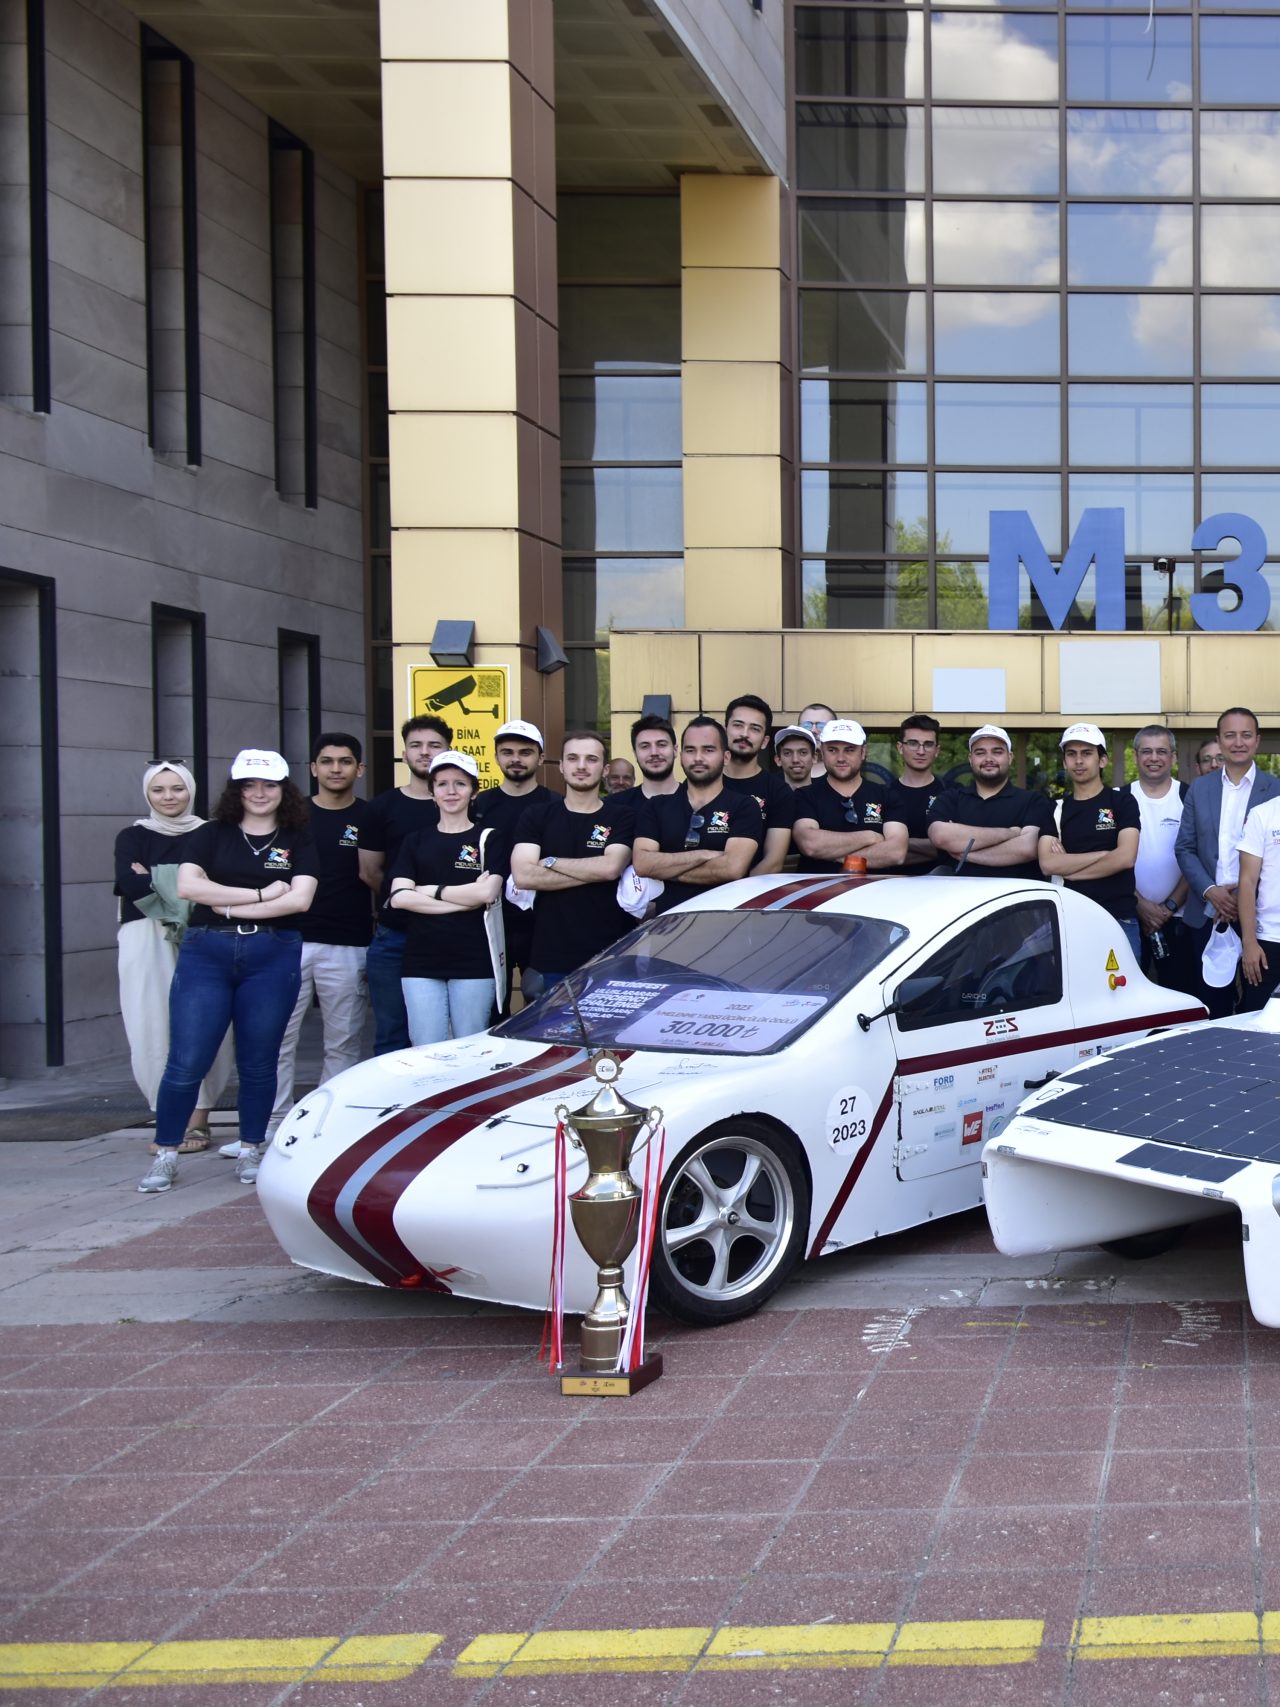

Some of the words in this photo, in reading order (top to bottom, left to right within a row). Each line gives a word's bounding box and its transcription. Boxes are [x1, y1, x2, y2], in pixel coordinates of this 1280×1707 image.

[988, 507, 1126, 631] M
[1190, 512, 1271, 632] 3
[456, 727, 480, 739] BİNA
[461, 745, 486, 756] SAAT
[983, 1017, 1019, 1036] ZES
[933, 1075, 955, 1087] FORD
[840, 1096, 857, 1116] 27
[832, 1119, 866, 1144] 2023
[964, 1120, 982, 1137] WE
